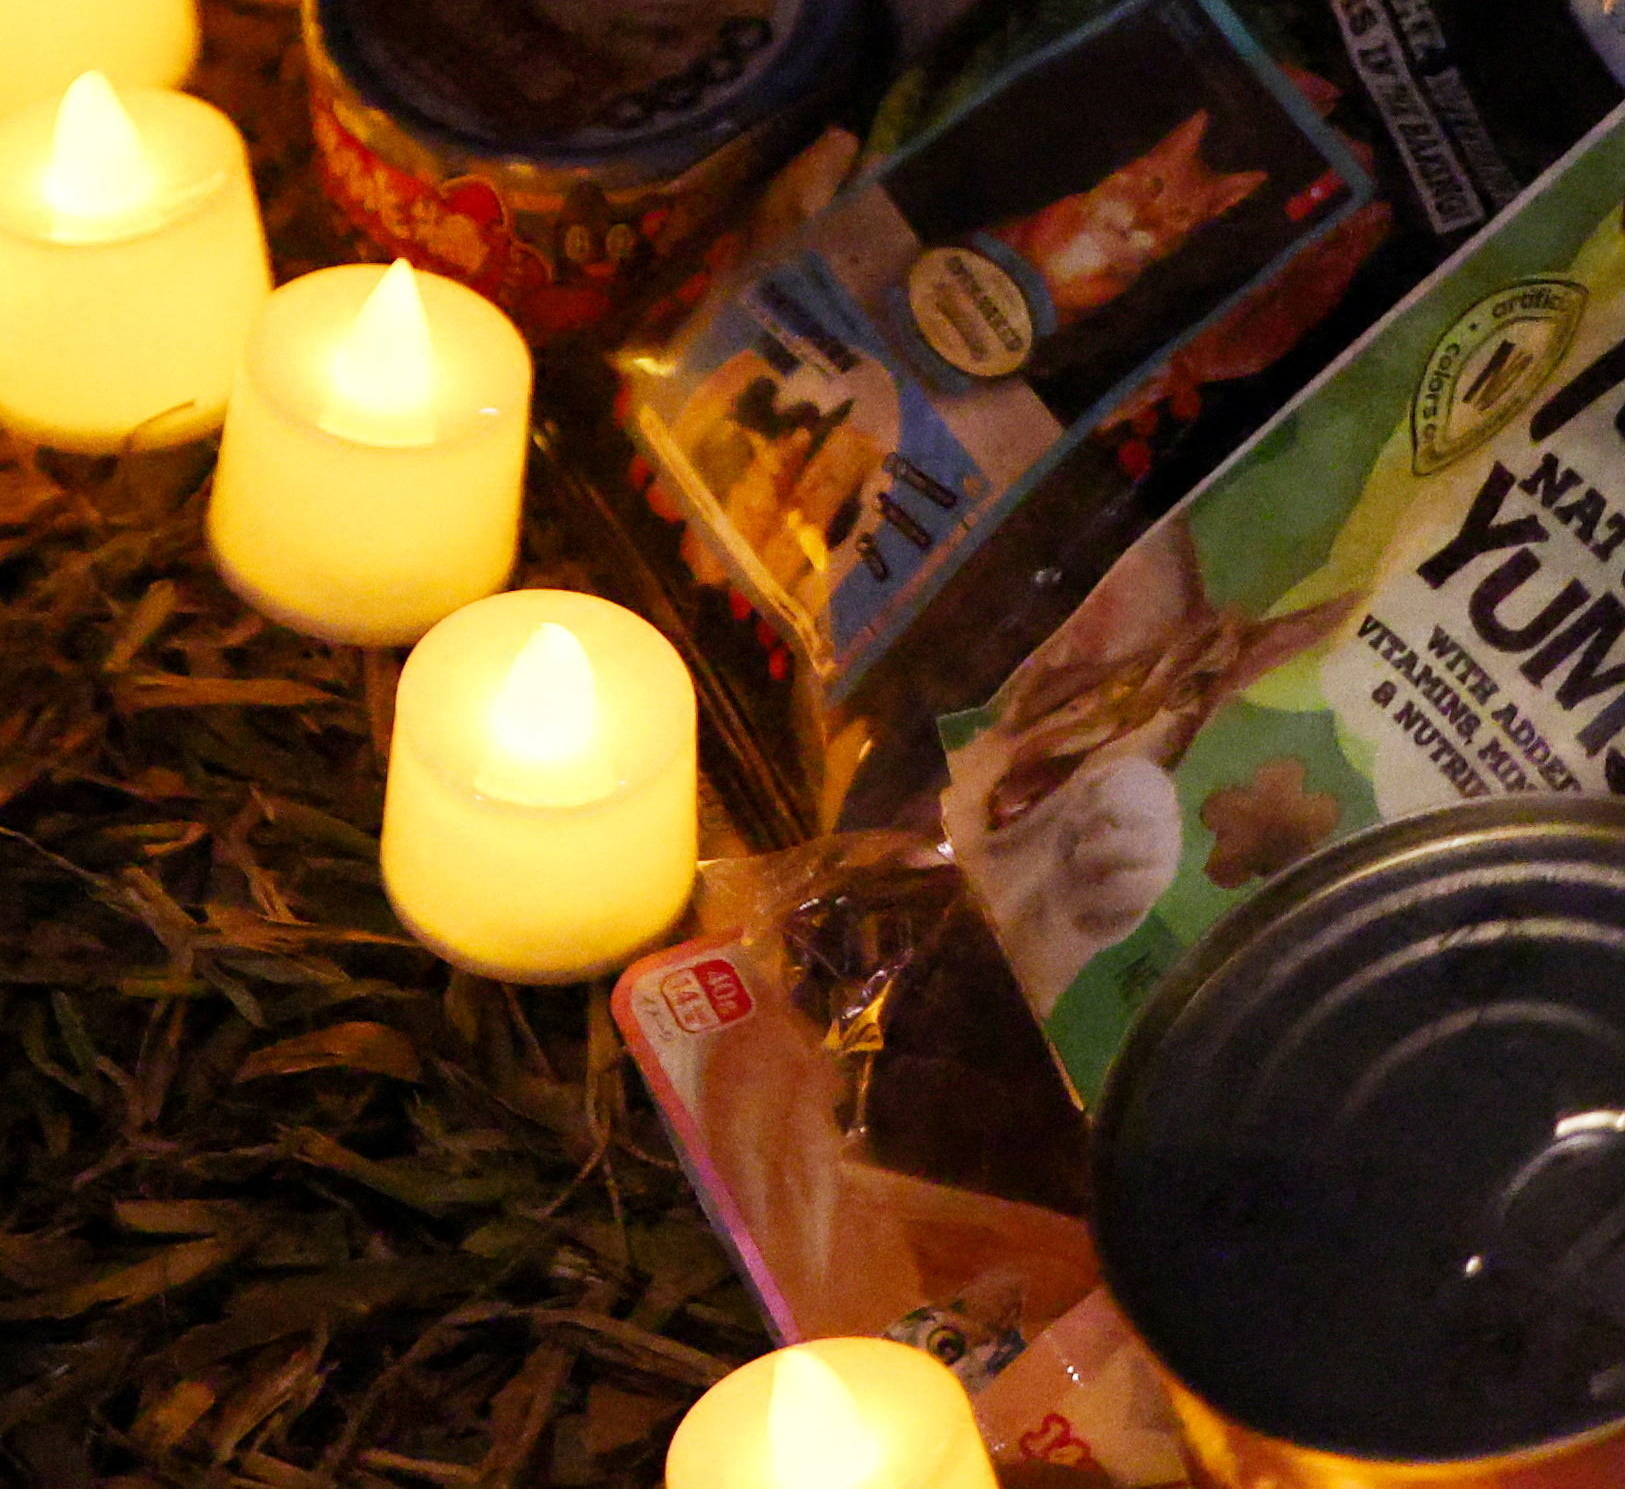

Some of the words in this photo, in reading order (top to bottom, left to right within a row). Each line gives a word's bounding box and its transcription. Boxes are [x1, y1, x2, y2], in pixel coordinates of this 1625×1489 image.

[1356, 612, 1482, 747] VITAMINS,
[1369, 678, 1395, 712] &
[1424, 623, 1498, 709] WITH
